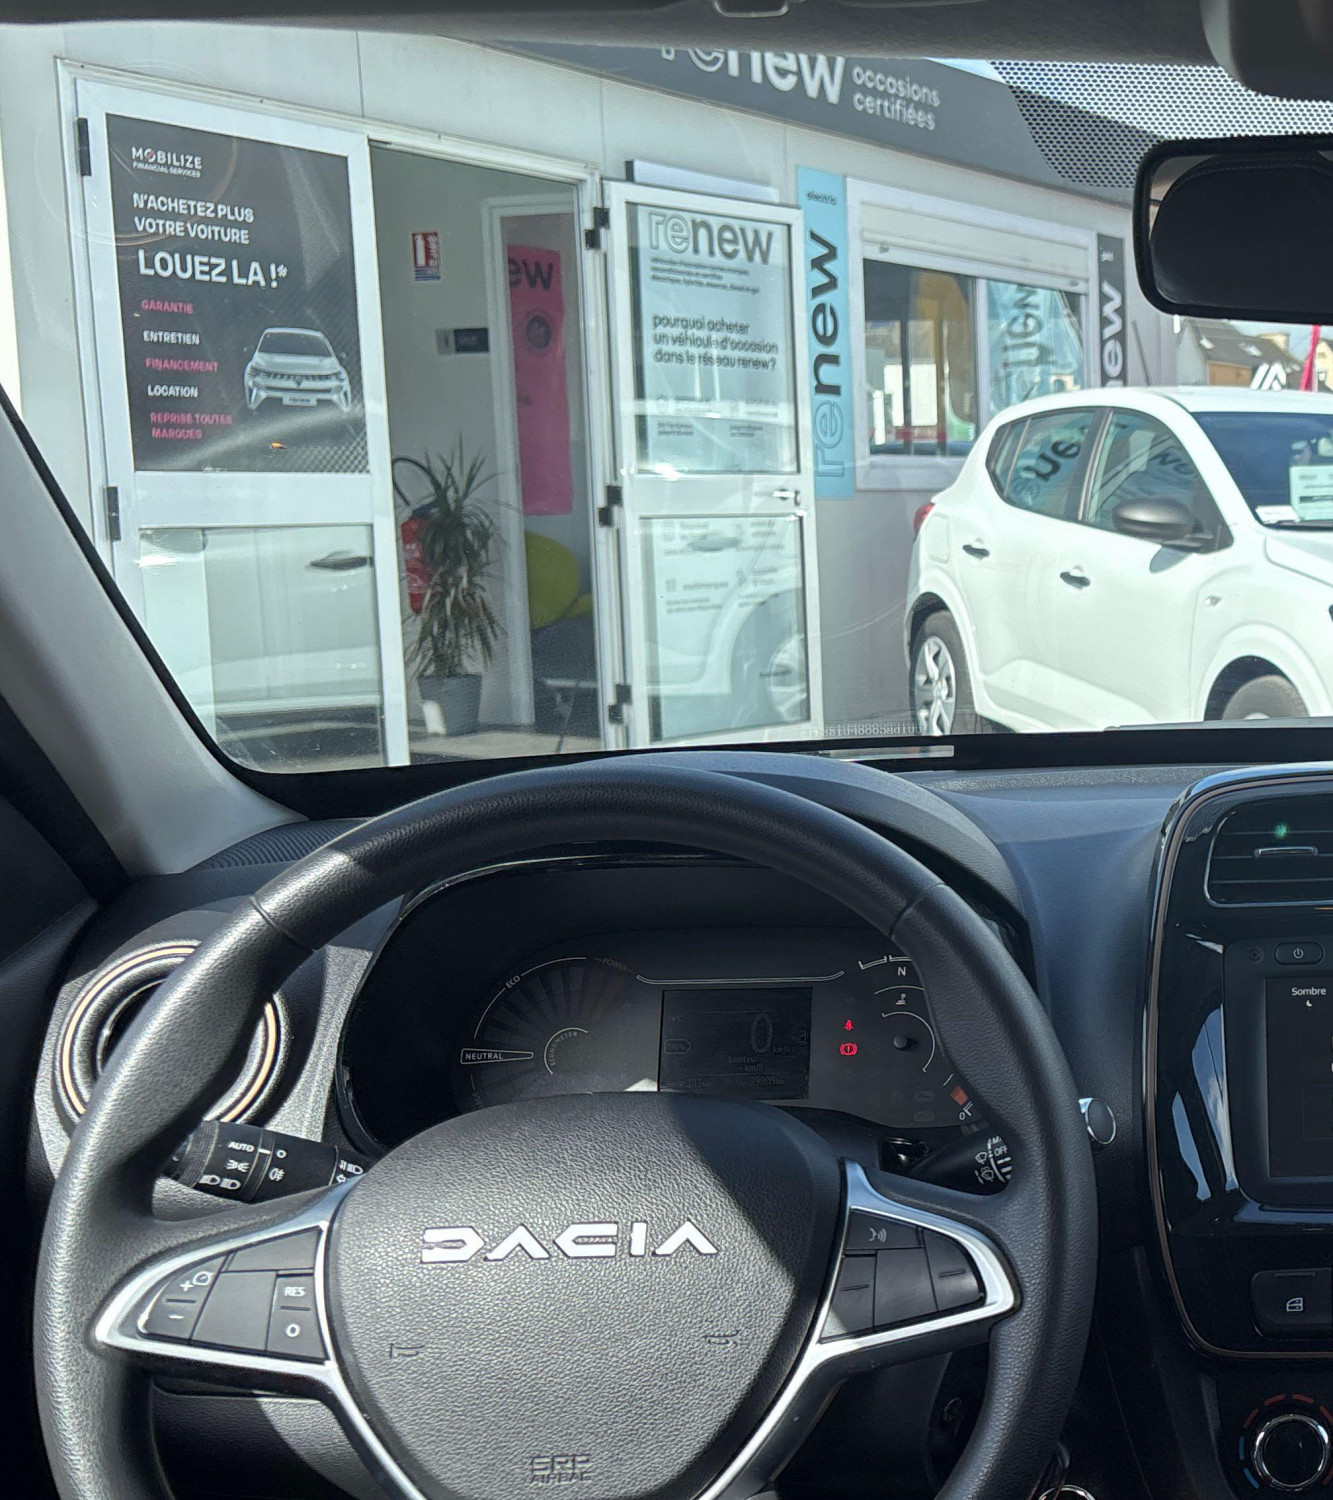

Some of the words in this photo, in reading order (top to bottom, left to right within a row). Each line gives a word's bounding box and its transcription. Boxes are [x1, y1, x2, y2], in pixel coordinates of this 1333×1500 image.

[852, 66, 941, 107] occasions
[852, 92, 937, 131] certifiées
[131, 146, 203, 170] MOBILIZE
[132, 192, 216, 218] N'ACHETEZ
[217, 203, 255, 223] PLUS
[134, 216, 186, 237] VOTRE
[187, 222, 250, 244] VOITURE
[647, 210, 774, 266] renew
[138, 249, 228, 283] LOUEZ
[231, 259, 267, 287] LA
[141, 299, 194, 315] GARANTIE
[653, 314, 705, 331] pourquoi
[707, 318, 749, 334] acheter
[143, 330, 200, 345] ENTRETIEN
[653, 332, 669, 345] un
[720, 335, 779, 354] d'occasion
[654, 348, 684, 364] dans
[809, 227, 846, 478] renew
[146, 357, 218, 372] FINANCEMENT
[147, 384, 199, 398] LOCATION
[150, 411, 193, 424] REPRISE
[152, 428, 203, 439] MARQUES
[897, 966, 907, 977] N
[505, 975, 521, 989] ECO
[1291, 986, 1327, 997] Sombre
[465, 1051, 503, 1060] NEUTRAL
[547, 1031, 578, 1067] ECONOMETER
[228, 1141, 254, 1153] AUTO
[994, 1145, 1009, 1156] OFF
[421, 1219, 719, 1263] DACIA
[284, 1285, 305, 1298] RES
